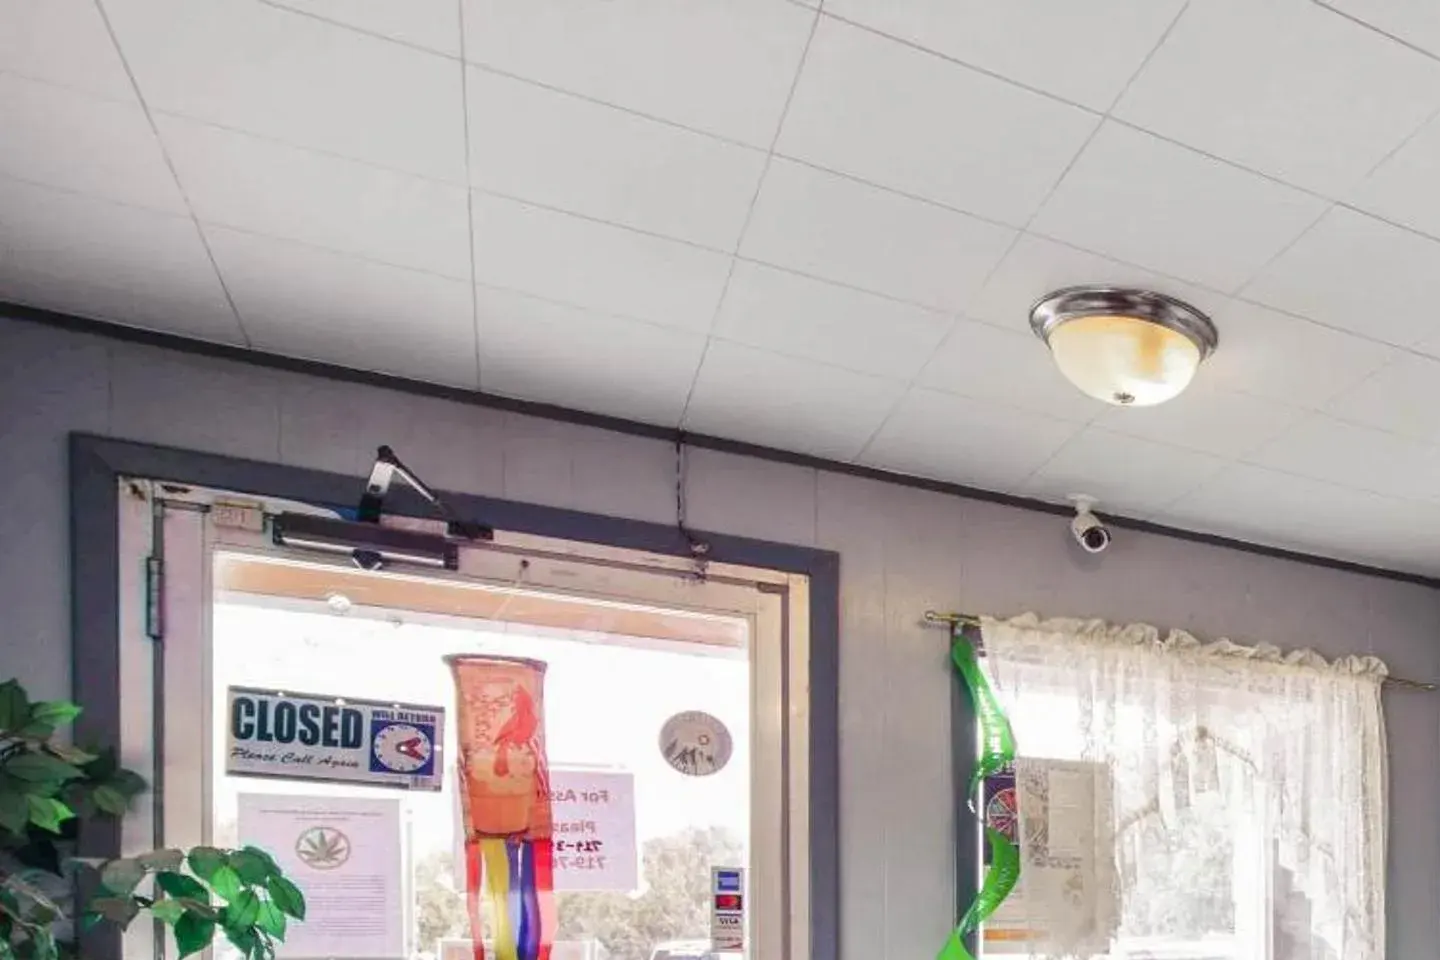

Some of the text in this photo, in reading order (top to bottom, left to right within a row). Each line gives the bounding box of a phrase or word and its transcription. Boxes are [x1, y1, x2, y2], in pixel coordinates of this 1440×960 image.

[231, 696, 363, 750] CLOSED
[231, 746, 360, 769] Please Call Again
